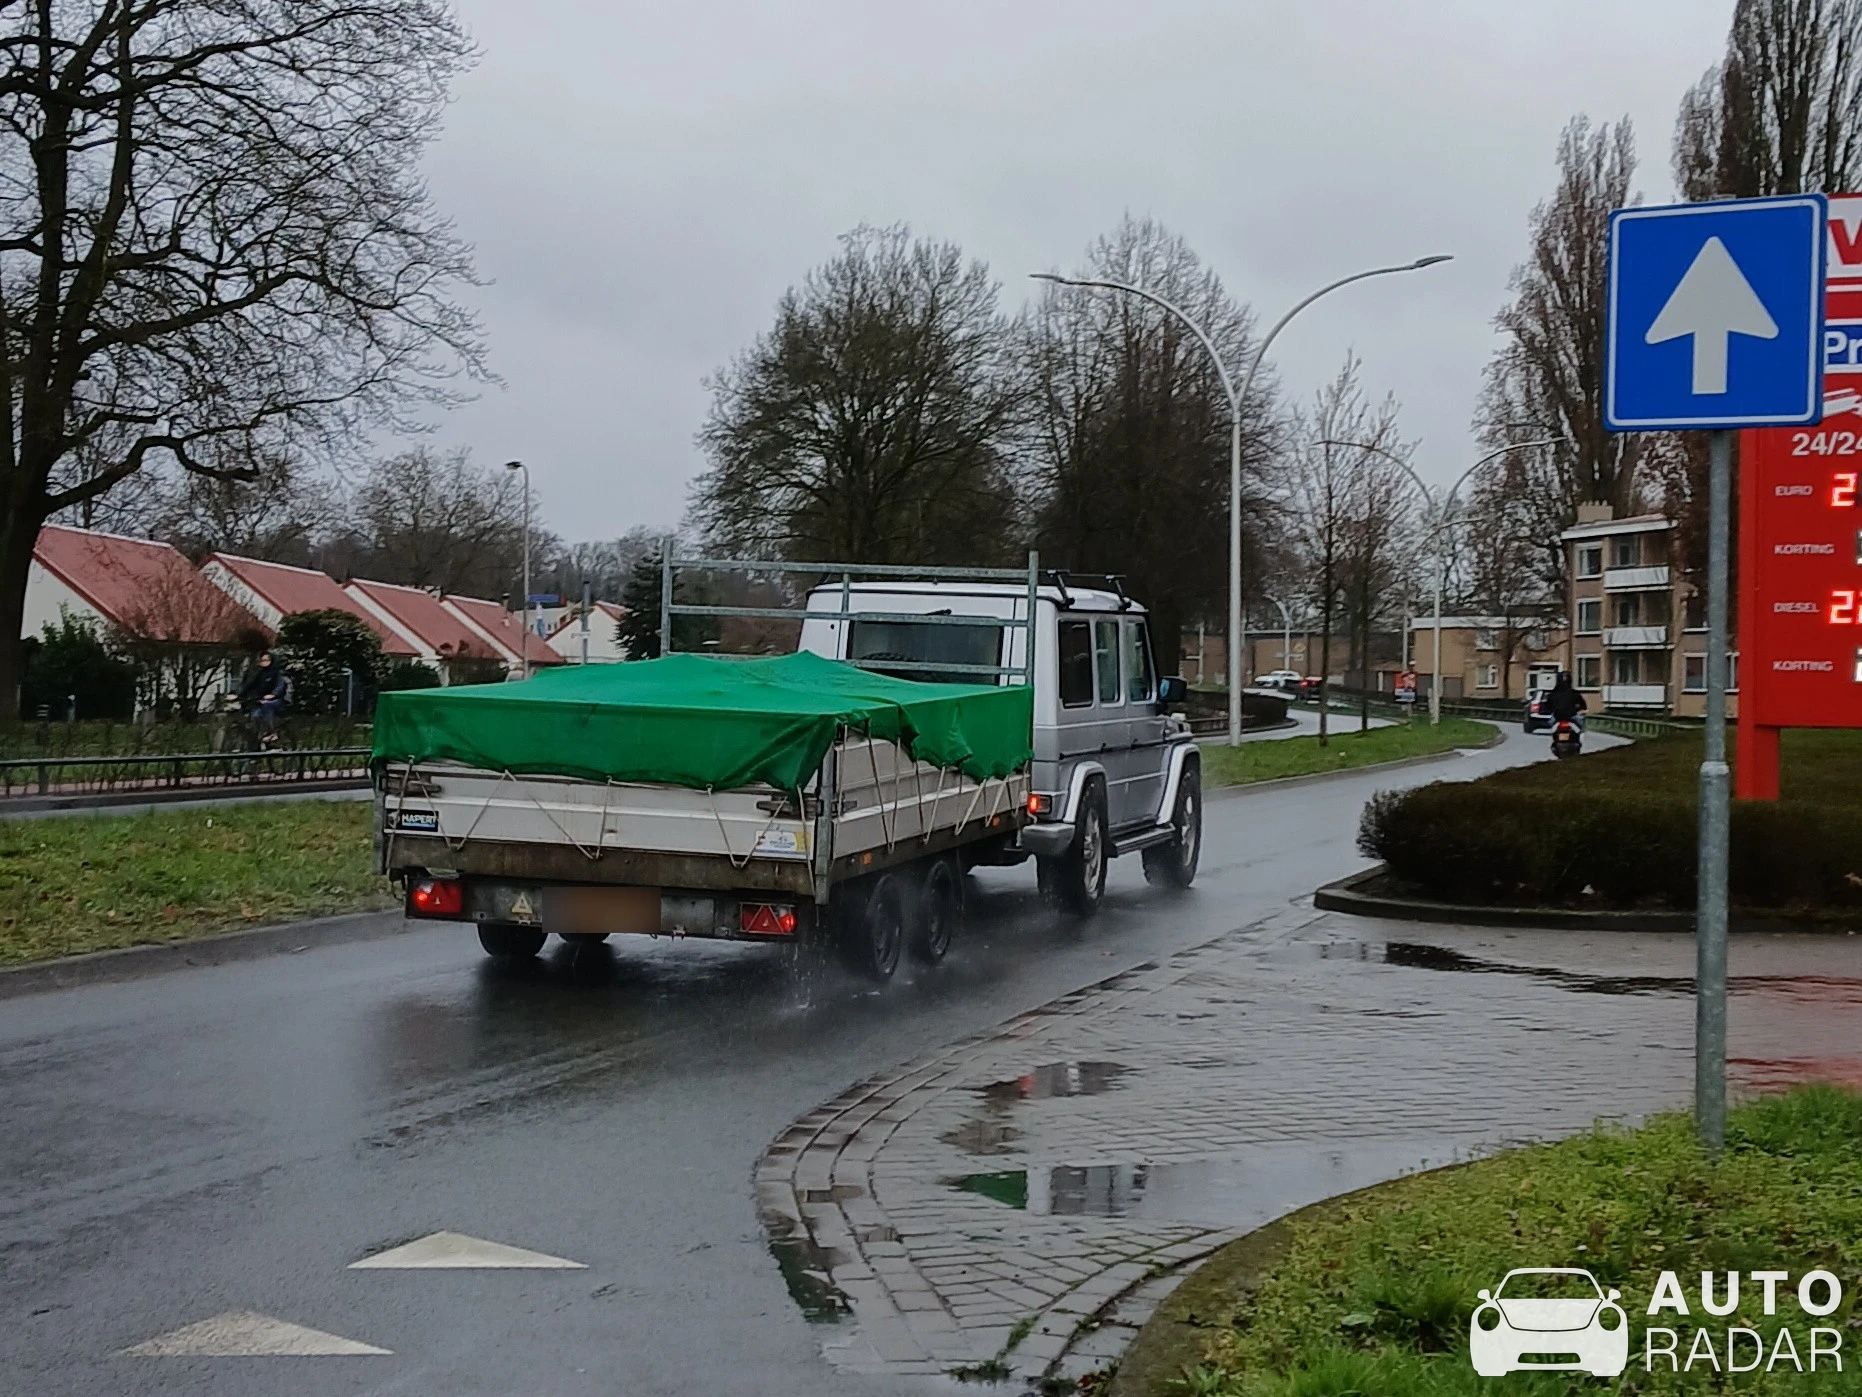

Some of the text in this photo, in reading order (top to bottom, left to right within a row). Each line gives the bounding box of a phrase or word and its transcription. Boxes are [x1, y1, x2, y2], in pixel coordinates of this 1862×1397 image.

[1775, 485, 1813, 496] EURO
[1774, 543, 1835, 555] KORTING
[1773, 602, 1820, 613] DIESEL
[1772, 660, 1834, 672] KORTING
